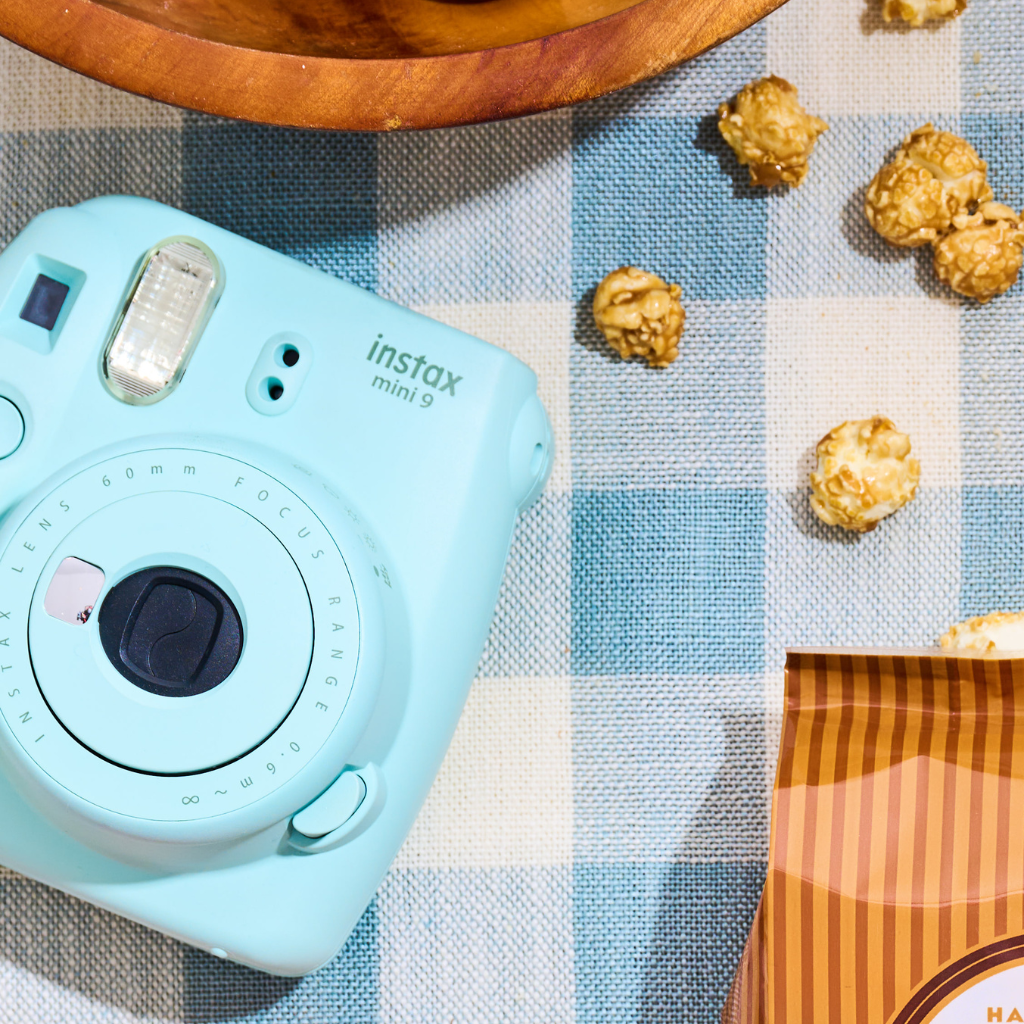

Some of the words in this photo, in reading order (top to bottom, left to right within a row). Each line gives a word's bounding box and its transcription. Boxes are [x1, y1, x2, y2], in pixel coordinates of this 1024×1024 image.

[366, 333, 464, 397] instax
[371, 375, 418, 403] mini
[419, 393, 434, 408] 9
[102, 464, 196, 487] 60mm
[11, 500, 70, 573] LENS
[234, 476, 325, 559] FOCUS
[0, 611, 45, 743] INSTAX
[315, 596, 345, 712] RANGE
